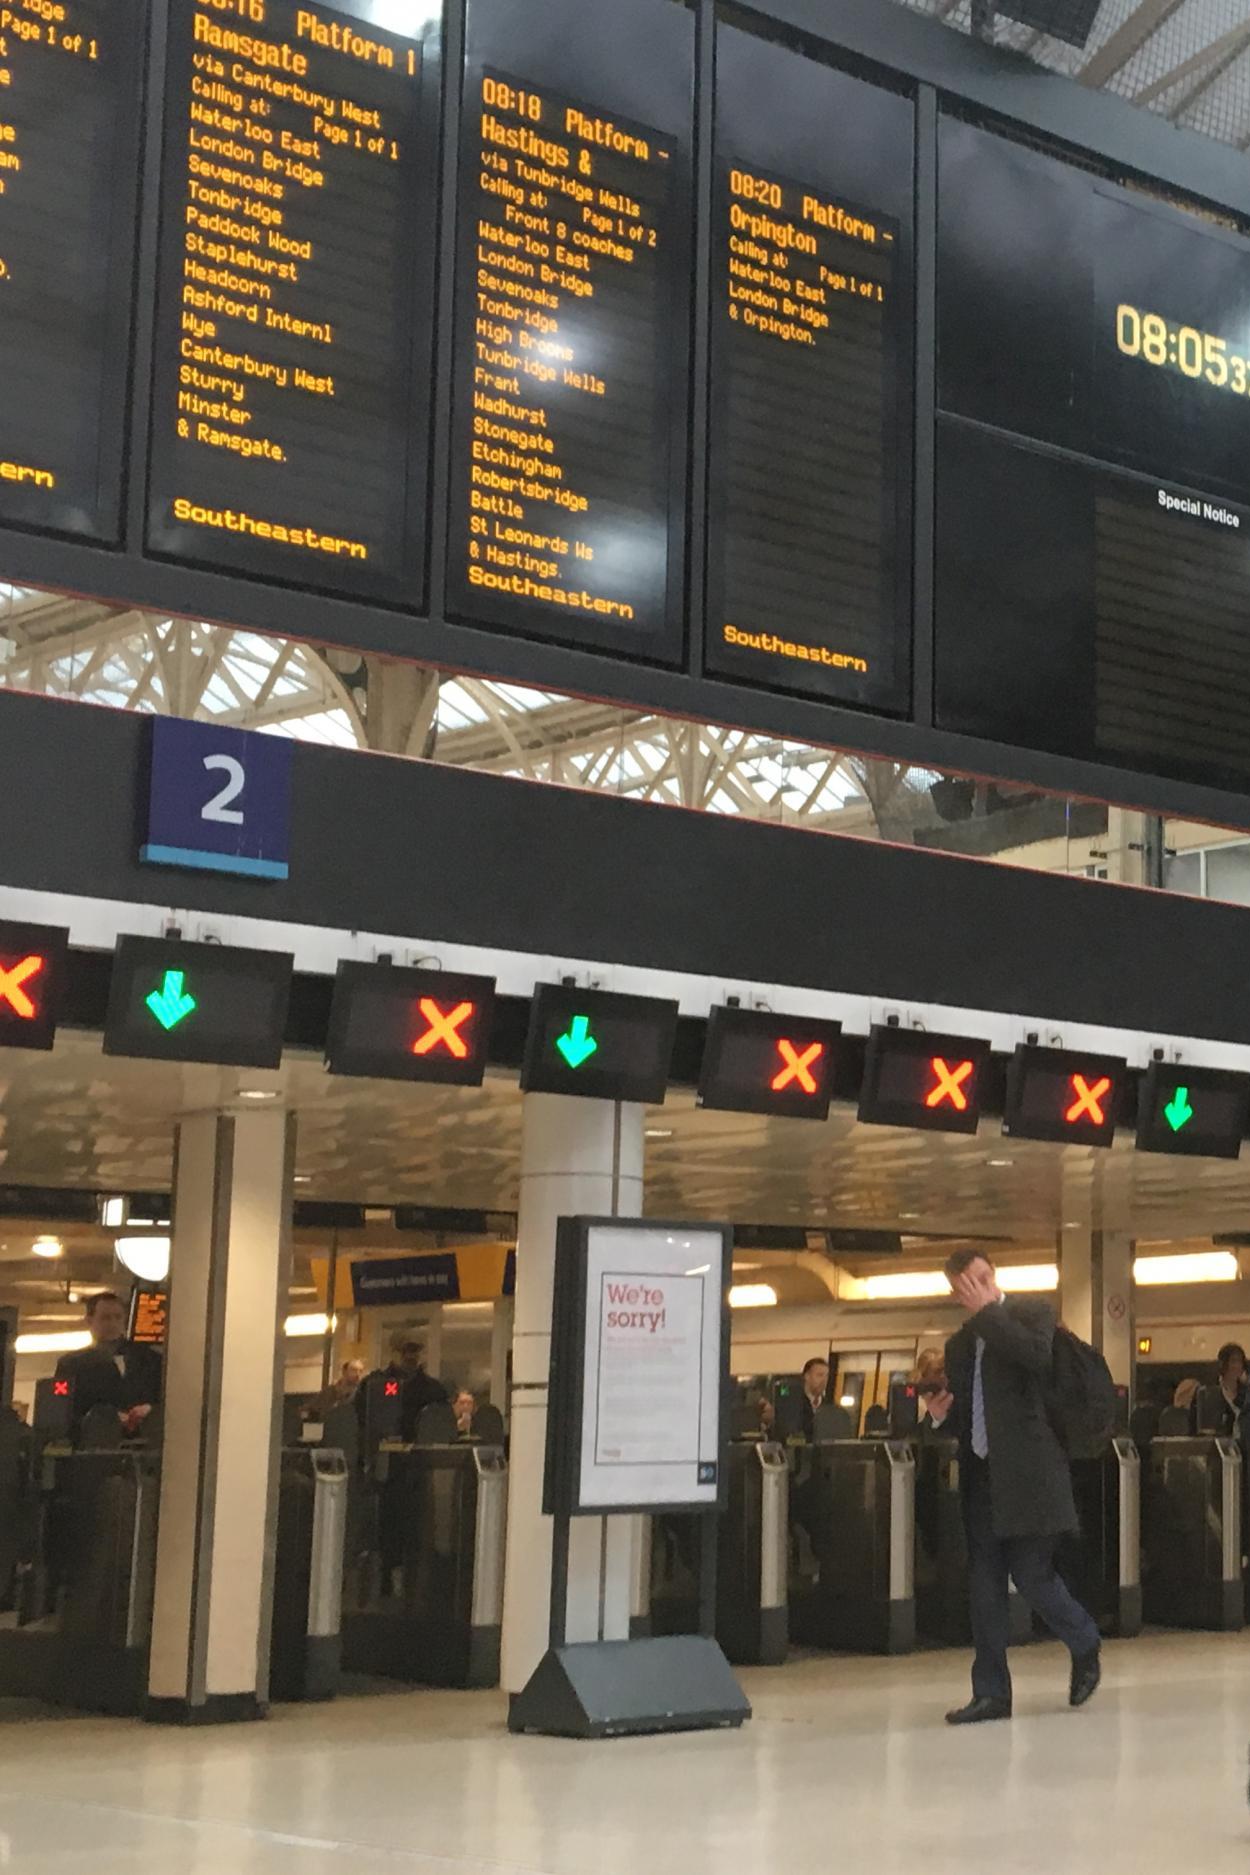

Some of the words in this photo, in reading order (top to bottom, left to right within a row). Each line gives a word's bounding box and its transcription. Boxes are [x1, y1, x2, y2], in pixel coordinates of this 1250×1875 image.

[197, 0, 264, 22] :16
[1, 9, 40, 40] Page
[47, 26, 55, 45] 1
[62, 34, 82, 53] of
[89, 40, 97, 59] 1
[194, 13, 308, 75] Ramsgate
[297, 9, 393, 68] Platform
[407, 49, 415, 75] 1
[192, 76, 242, 112] Calling
[193, 54, 224, 77] via
[232, 63, 334, 117] Canterbury
[342, 100, 380, 129] West
[190, 103, 273, 143] Waterloo
[281, 127, 321, 159] East
[314, 116, 348, 144] Page
[354, 130, 361, 147] 1
[368, 138, 384, 153] of
[391, 142, 398, 159] 1
[482, 77, 541, 121] 08:18
[566, 108, 648, 160] Platform
[190, 129, 254, 164] London
[263, 152, 323, 186] Bridge
[481, 114, 569, 167] Hastings
[579, 150, 591, 175] &
[188, 155, 283, 198] Sevenoaks
[480, 173, 524, 205] Calling
[481, 152, 508, 172] via
[515, 160, 594, 201] Tunbridge
[600, 189, 640, 217] Wells
[188, 180, 282, 225] Tonbridge
[730, 170, 781, 209] 08:20
[803, 196, 875, 243] Platform
[186, 207, 260, 244] Paddock
[269, 232, 311, 259] Wood
[479, 220, 549, 258] Waterloo
[556, 246, 590, 271] East
[506, 204, 549, 234] Front
[557, 222, 567, 240] 8
[573, 231, 634, 260] coaches
[583, 207, 612, 232] Page
[618, 220, 624, 235] 1
[630, 225, 643, 241] of
[649, 230, 656, 247] 2
[730, 204, 817, 255] Orpington
[185, 235, 298, 281] Staplehurst
[478, 245, 534, 277] London
[541, 264, 593, 297] Bridge
[730, 235, 768, 265] Calling
[185, 261, 270, 299] Headcorn
[478, 269, 559, 309] Sevenoaks
[730, 258, 790, 292] Waterloo
[796, 280, 826, 304] East
[820, 265, 846, 290] Page
[851, 277, 856, 292] 1
[860, 282, 873, 298] of
[878, 286, 883, 302] 1
[182, 312, 216, 338] Wye
[184, 286, 258, 322] Ashford
[265, 304, 332, 343] Internl
[478, 293, 558, 333] Tonbridge
[729, 281, 777, 311] London
[783, 298, 829, 328] Bridge
[729, 303, 738, 320] &
[744, 308, 816, 346] Orpington.
[476, 318, 512, 345] High
[180, 366, 244, 401] Sturry
[181, 339, 288, 386] Canterbury
[295, 370, 334, 395] West
[475, 367, 520, 395] Frant
[477, 343, 556, 381] Tunbridge
[564, 368, 605, 395] Wells
[179, 391, 251, 424] Minster
[474, 391, 546, 427] Wadhurst
[178, 419, 189, 438] &
[198, 423, 287, 462] Ramsgate.
[473, 416, 554, 454] Stonegate
[473, 440, 562, 479] Etchingham
[471, 465, 588, 511] Robertsbridge
[471, 490, 523, 519] Battle
[1158, 489, 1201, 517] Special
[1203, 503, 1239, 528] Notice
[174, 499, 367, 559] Southeastern
[470, 516, 488, 535] St
[496, 521, 568, 555] Leonards
[470, 541, 479, 558] &
[487, 545, 562, 579] Hastings.
[469, 565, 634, 619] Southeastern
[723, 624, 867, 672] Southeastern
[201, 754, 245, 824] 2
[607, 1283, 664, 1306] We're
[607, 1307, 665, 1333] sorry!
